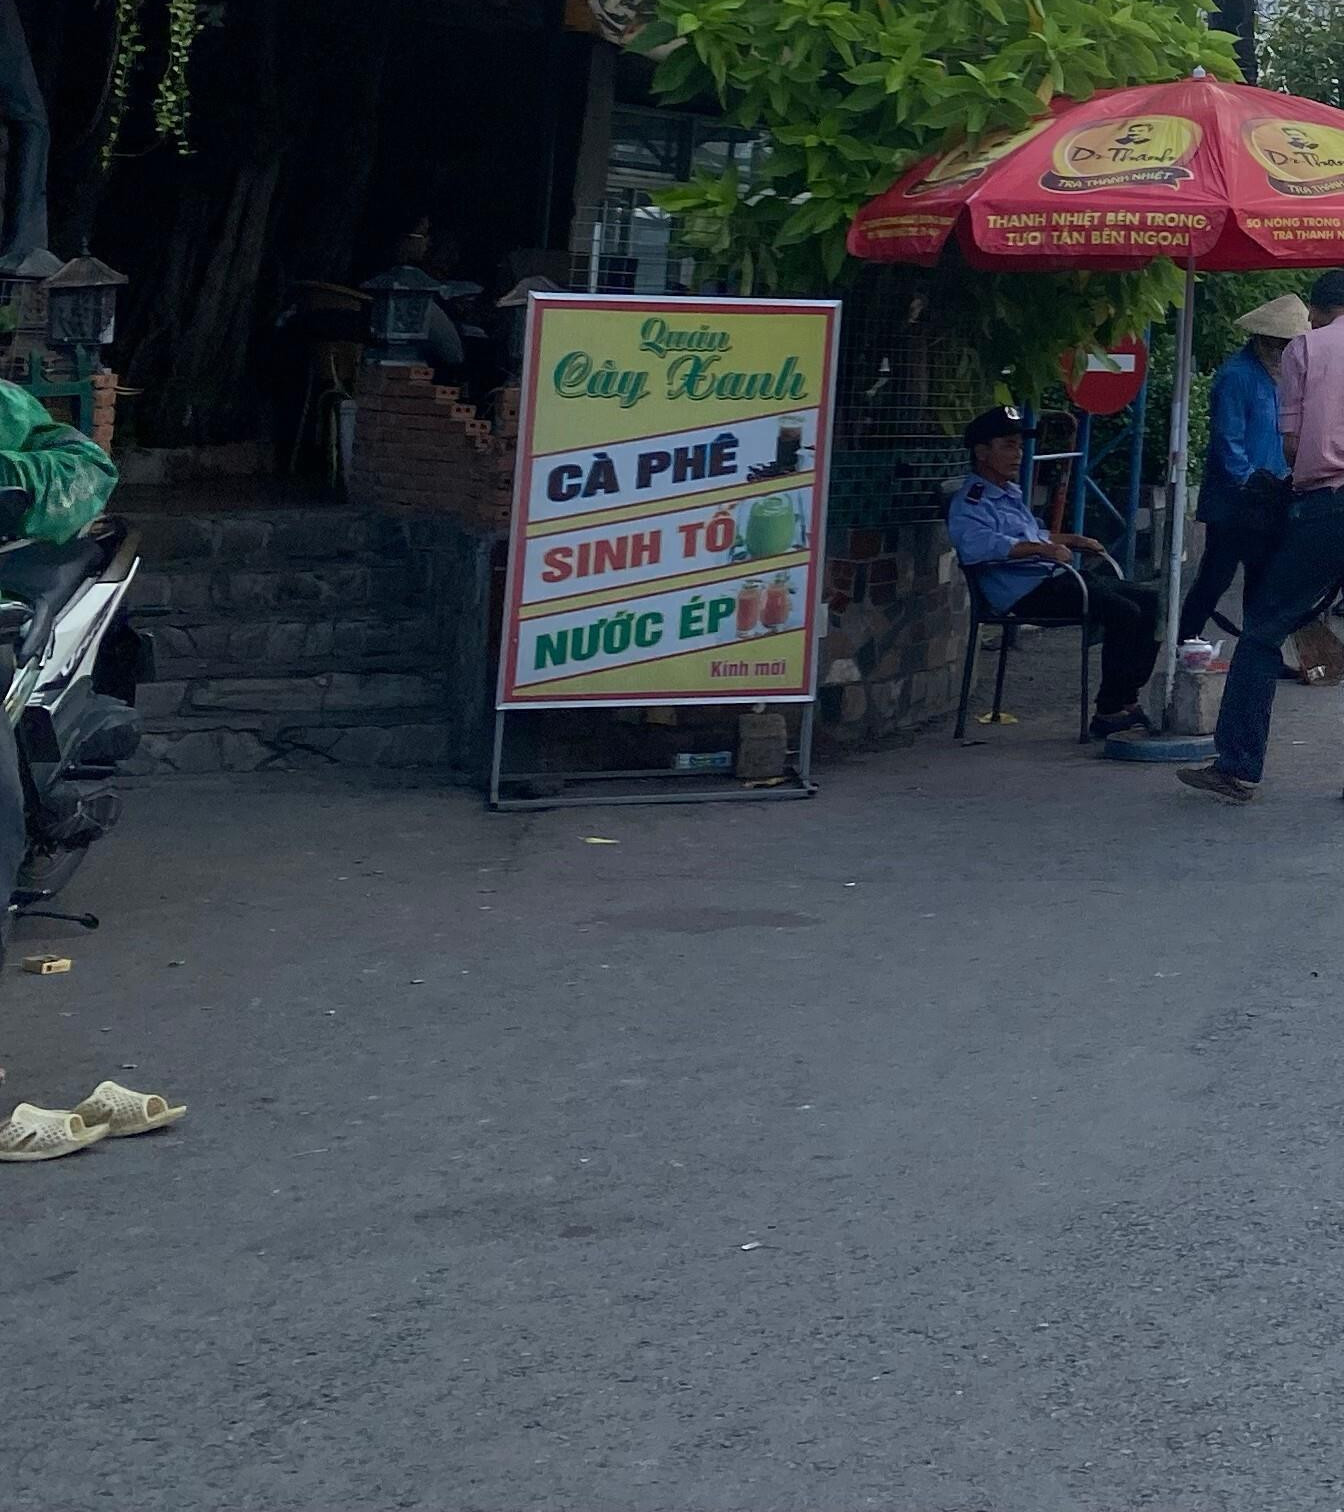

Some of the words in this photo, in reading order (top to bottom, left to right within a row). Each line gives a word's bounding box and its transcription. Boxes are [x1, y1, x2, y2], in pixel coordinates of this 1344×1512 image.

[987, 213, 1047, 228] THANH
[1105, 210, 1140, 225] BÊN
[1091, 228, 1126, 245] BÊN
[1295, 229, 1334, 240] THANH
[1302, 217, 1340, 228] TRONG
[640, 317, 733, 358] Quán
[553, 350, 651, 408] Cây
[666, 354, 808, 400] Xanh
[547, 452, 620, 503] CÀ
[636, 432, 739, 489] PHÊ
[542, 530, 662, 583] SINH
[678, 503, 737, 558] TỐ
[534, 610, 664, 670] NƯỚC
[679, 595, 736, 640] ÉP
